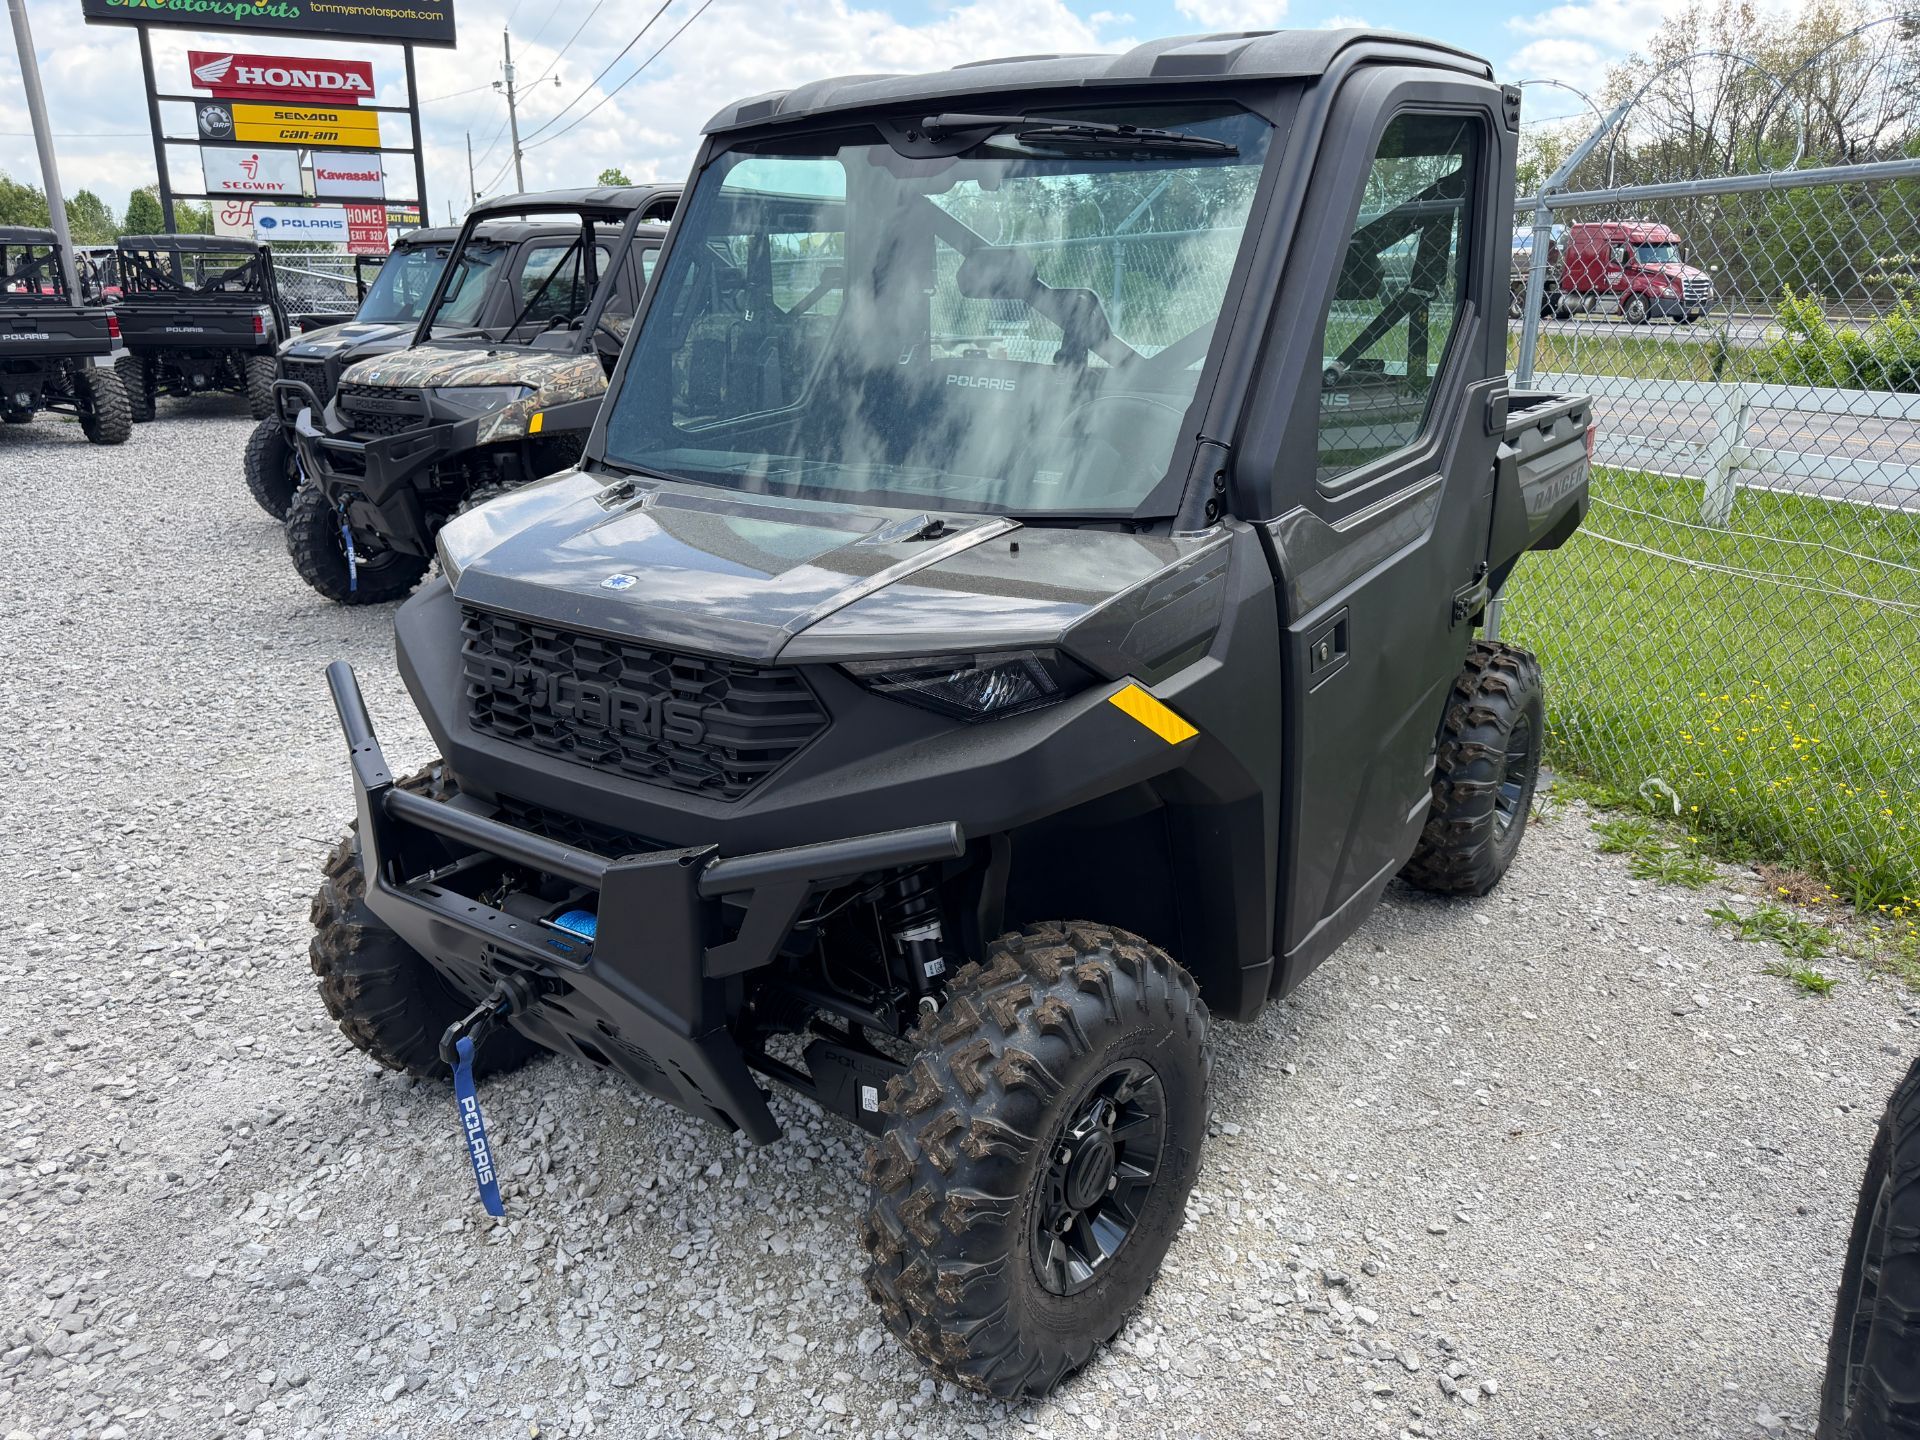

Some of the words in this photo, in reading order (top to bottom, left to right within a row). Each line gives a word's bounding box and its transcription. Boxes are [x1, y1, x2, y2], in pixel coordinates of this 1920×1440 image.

[310, 1, 444, 21] tommysmotorsports.com
[235, 66, 371, 92] HONDA
[213, 121, 231, 129] BRP
[279, 129, 339, 141] can-am
[316, 168, 380, 182] Kawasaki
[222, 181, 286, 191] SEGWAY
[282, 219, 343, 229] POLARIS
[347, 208, 383, 224] HOME!
[386, 213, 402, 223] EXIT
[351, 230, 367, 241] EXIT
[369, 230, 383, 241] 320
[2, 333, 50, 341] POLARIS
[548, 362, 597, 385] XP
[554, 375, 593, 391] 1000
[946, 374, 1017, 391] POLARIS
[1532, 464, 1585, 513] RANGER
[484, 658, 707, 746] POLARIS
[461, 1095, 494, 1185] POLARIS
